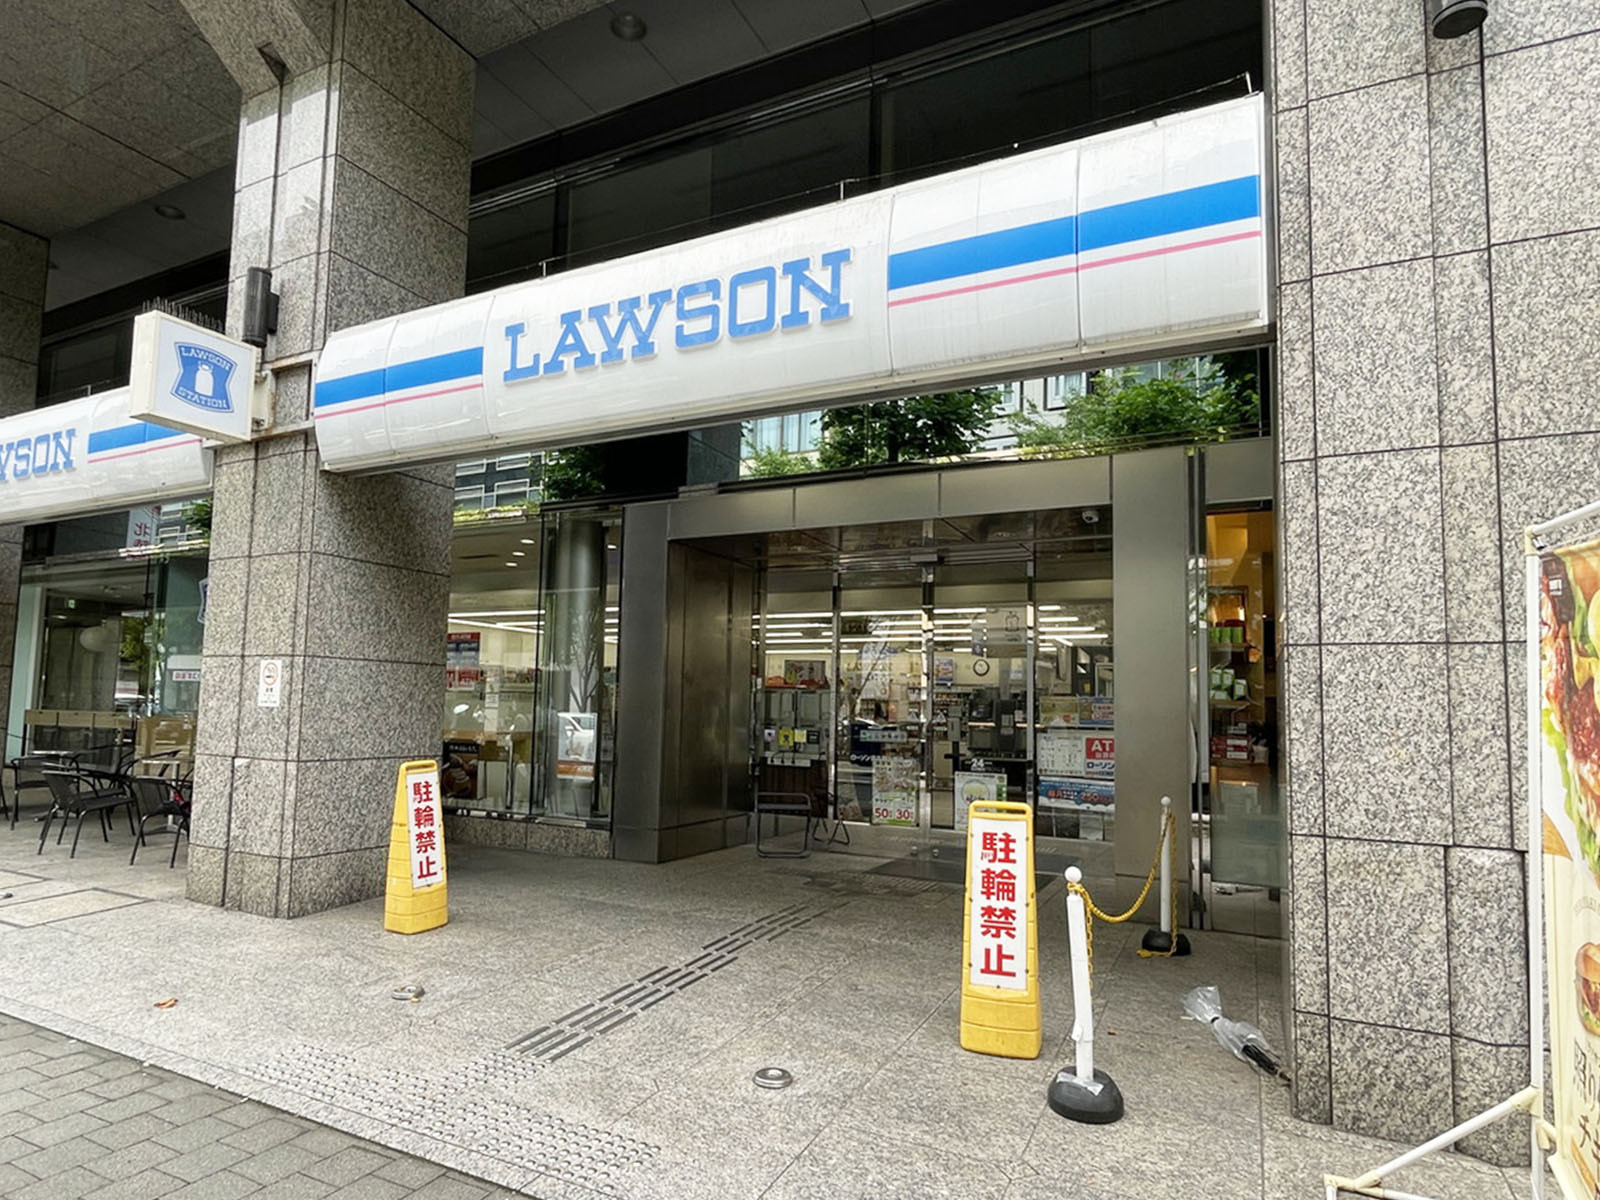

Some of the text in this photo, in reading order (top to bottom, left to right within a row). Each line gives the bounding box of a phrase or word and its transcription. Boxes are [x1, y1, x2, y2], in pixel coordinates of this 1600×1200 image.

[180, 347, 232, 371] LAWSON
[503, 247, 852, 383] LAWSON
[177, 386, 228, 408] STATION
[412, 780, 438, 880] 駐輪禁止
[980, 831, 1018, 978] 駐輪禁止
